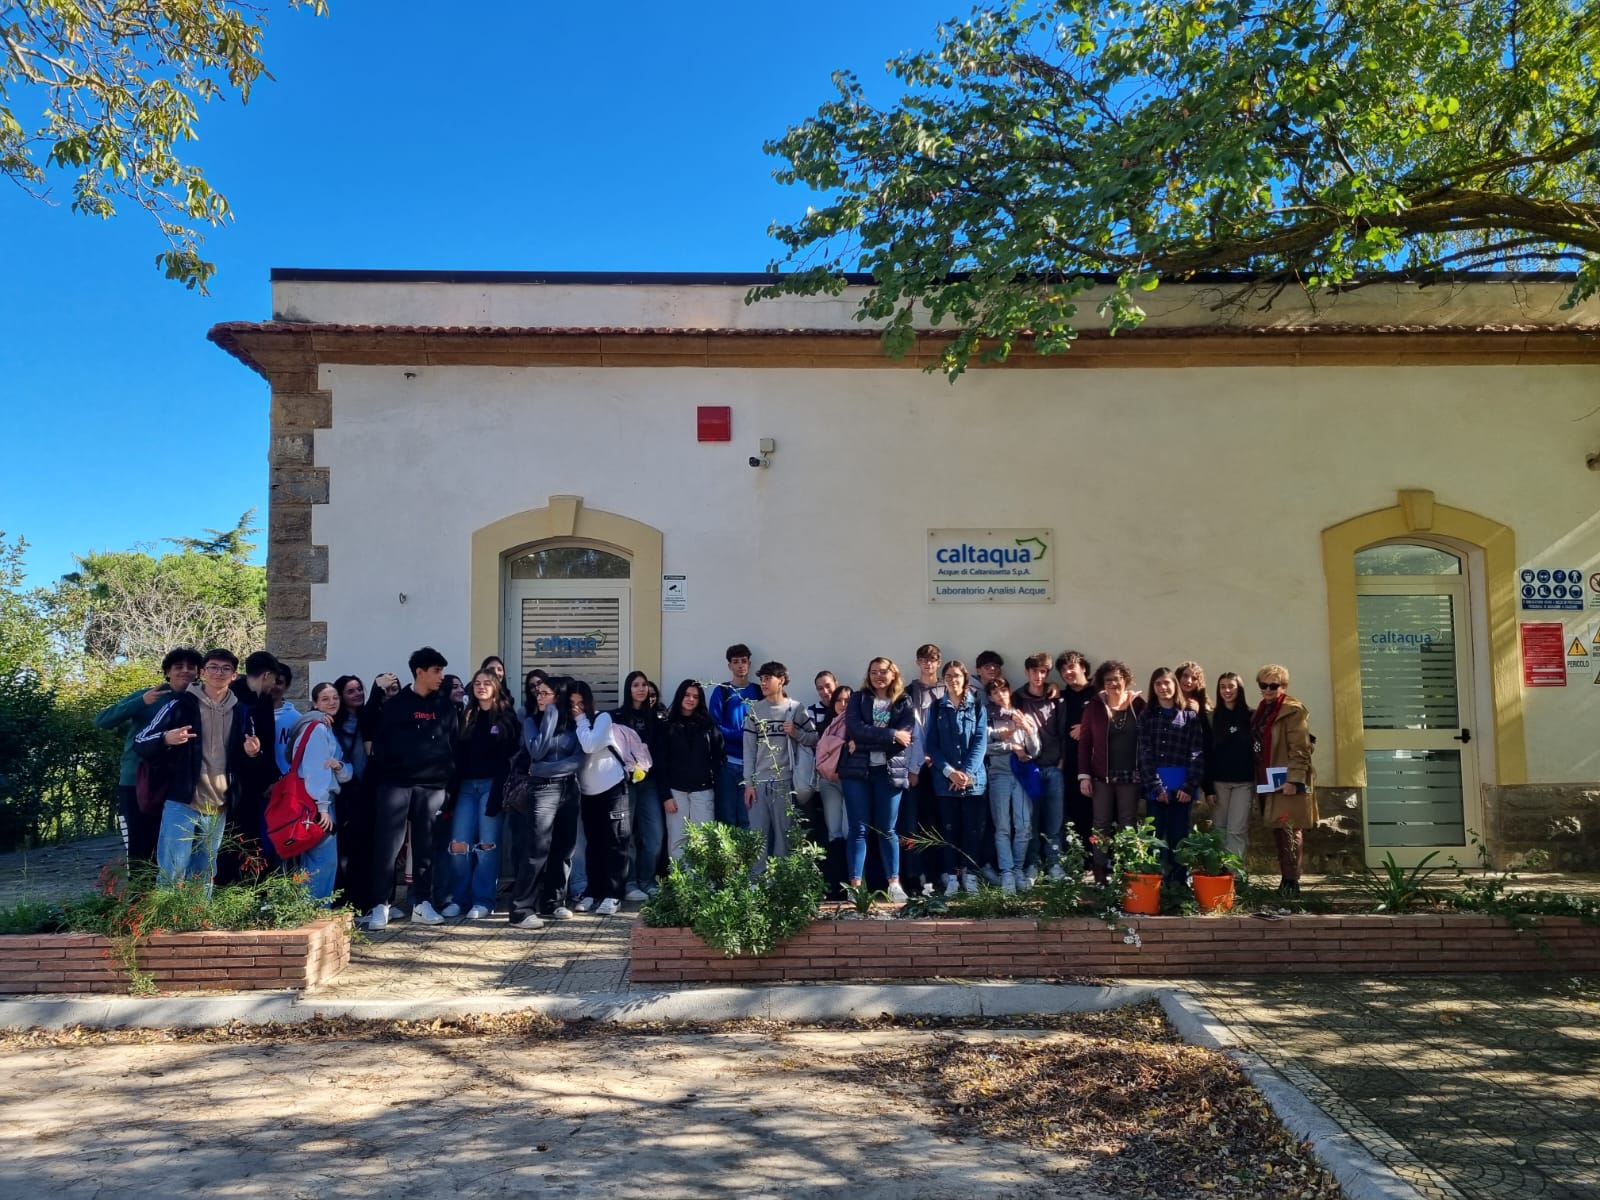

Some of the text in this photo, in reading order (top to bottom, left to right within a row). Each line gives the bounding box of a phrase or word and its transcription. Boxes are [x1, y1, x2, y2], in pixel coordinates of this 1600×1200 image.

[936, 543, 1031, 568] caltaqua
[937, 568, 959, 576] Acque
[1012, 568, 1030, 576] S.p.A.
[936, 586, 1046, 597] Laboratorio Analisi Acque
[535, 635, 596, 650] caltaqua
[1371, 631, 1432, 646] caltaqua
[1567, 660, 1590, 668] PERICOLO
